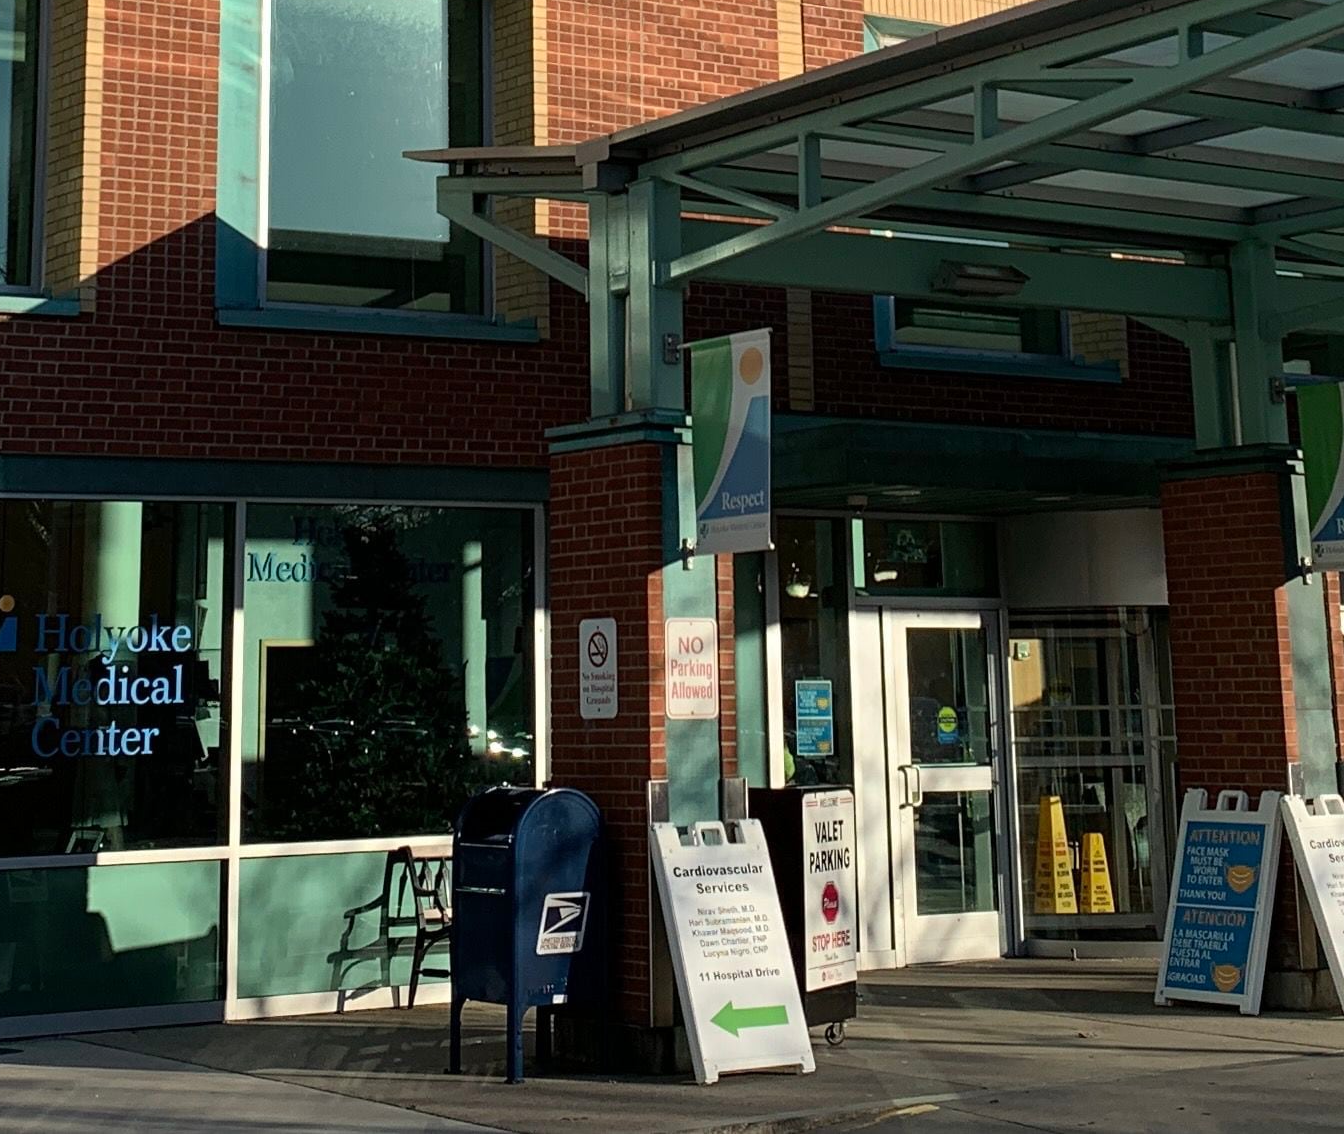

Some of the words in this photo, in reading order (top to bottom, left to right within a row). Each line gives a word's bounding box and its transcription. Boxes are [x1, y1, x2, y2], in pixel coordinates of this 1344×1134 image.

[722, 490, 765, 513] Respect
[247, 551, 346, 583] Medic
[34, 613, 192, 664] Holyoke
[678, 637, 704, 655] NO
[590, 671, 615, 682] Smoking
[670, 659, 713, 680] Parking
[32, 664, 185, 706] Medical
[671, 682, 713, 699] Allowed
[32, 717, 159, 757] Center
[815, 820, 844, 844] VALET
[1189, 829, 1261, 845] ATTENTION
[1187, 846, 1205, 856] FACE
[1207, 847, 1230, 858] MASK
[810, 847, 850, 874] PARKING
[1191, 856, 1212, 866] MUST
[1214, 857, 1224, 867] BE
[673, 863, 763, 878] Cardiovascular
[1193, 866, 1218, 875] WORN
[696, 882, 749, 894] Services
[1187, 875, 1197, 884] TO
[1199, 876, 1223, 886] ENTER
[1179, 889, 1205, 899] THANK
[1207, 891, 1227, 901] YOU!
[812, 932, 831, 953] STOP
[832, 929, 851, 948] HERE
[1173, 929, 1183, 938] LA
[1185, 929, 1235, 942] MASCARILLA
[1172, 938, 1192, 947] DEBE
[1194, 939, 1228, 951] TRAERLA
[1171, 947, 1200, 958] PUESTA
[1201, 950, 1211, 960] AL
[1170, 957, 1200, 968] ENTRAR
[699, 972, 711, 981] 11
[714, 969, 753, 981] Hospital
[755, 967, 780, 977] Drive
